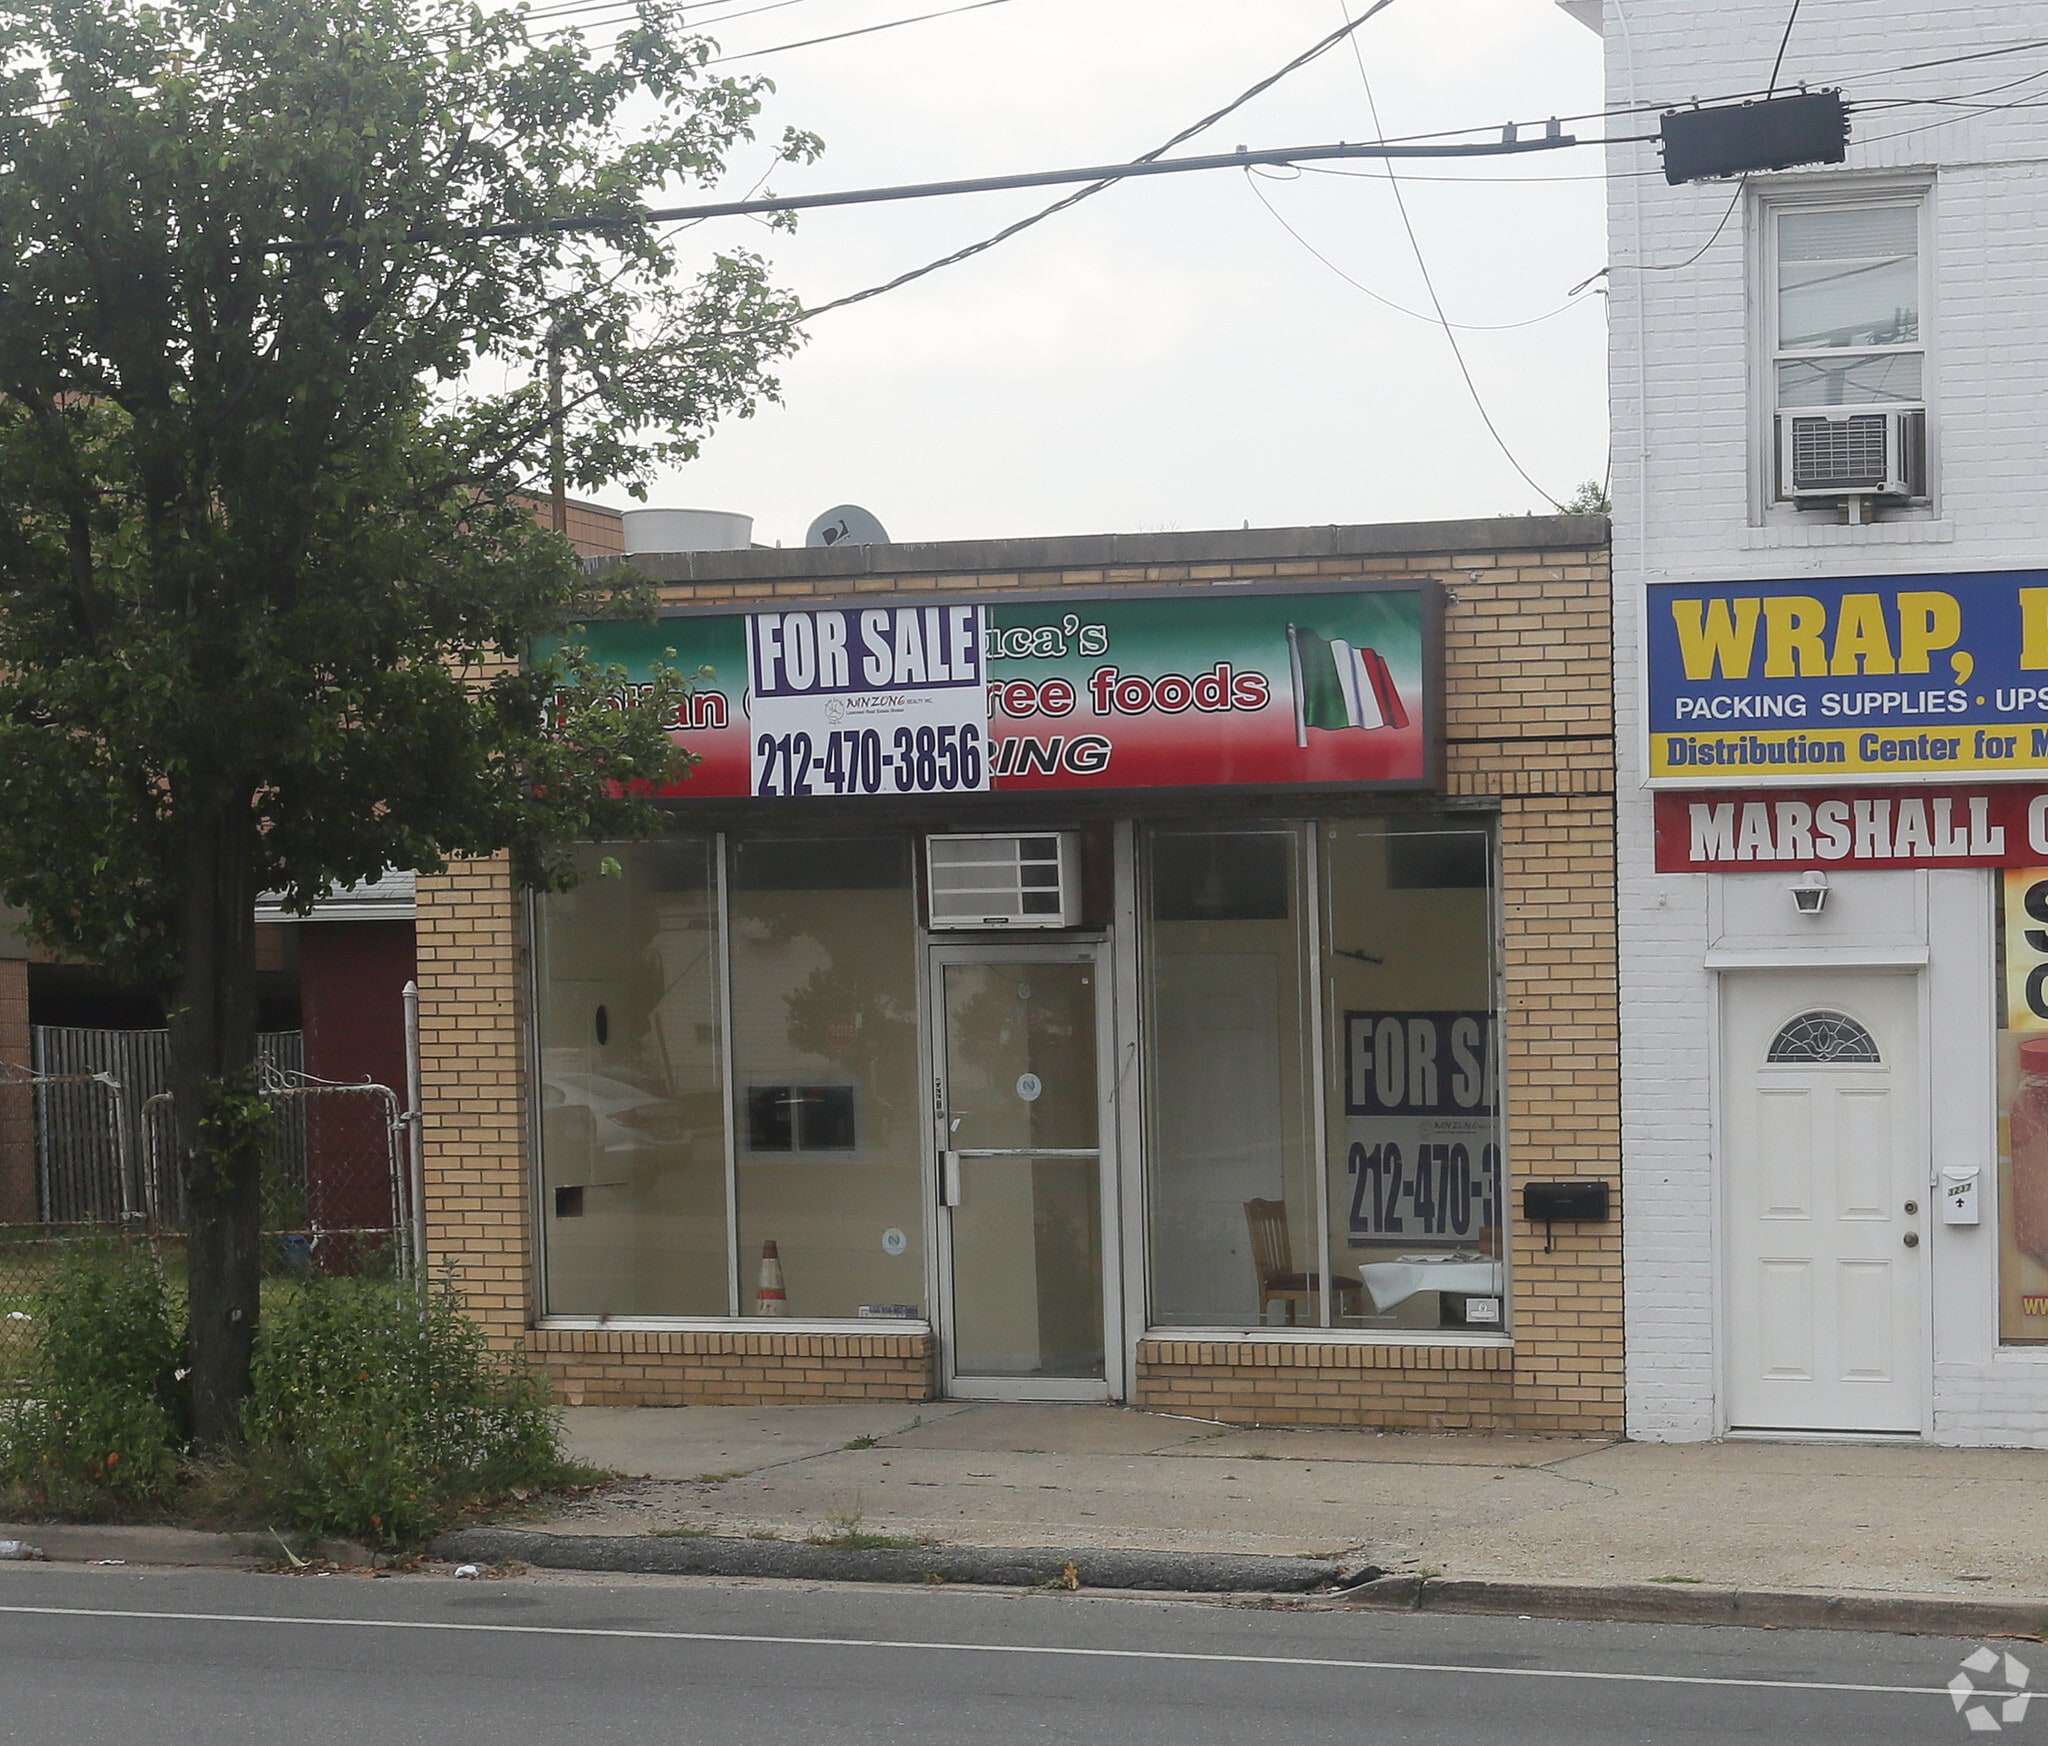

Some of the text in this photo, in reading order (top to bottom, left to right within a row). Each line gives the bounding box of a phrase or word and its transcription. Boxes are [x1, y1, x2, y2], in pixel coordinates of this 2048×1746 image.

[757, 605, 976, 691] FOR SALE
[1671, 590, 1975, 686] WRAP,
[1089, 663, 1270, 715] foods
[1675, 695, 1807, 720] PACKING
[1820, 689, 1968, 717] SUPPLIES
[757, 722, 981, 796] 212-470-3856
[1667, 734, 1845, 766] Distribution
[1859, 733, 1961, 763] Center
[1974, 730, 2018, 759] for
[1688, 796, 2005, 862] MARSHALL
[1350, 1016, 1438, 1107] FOR
